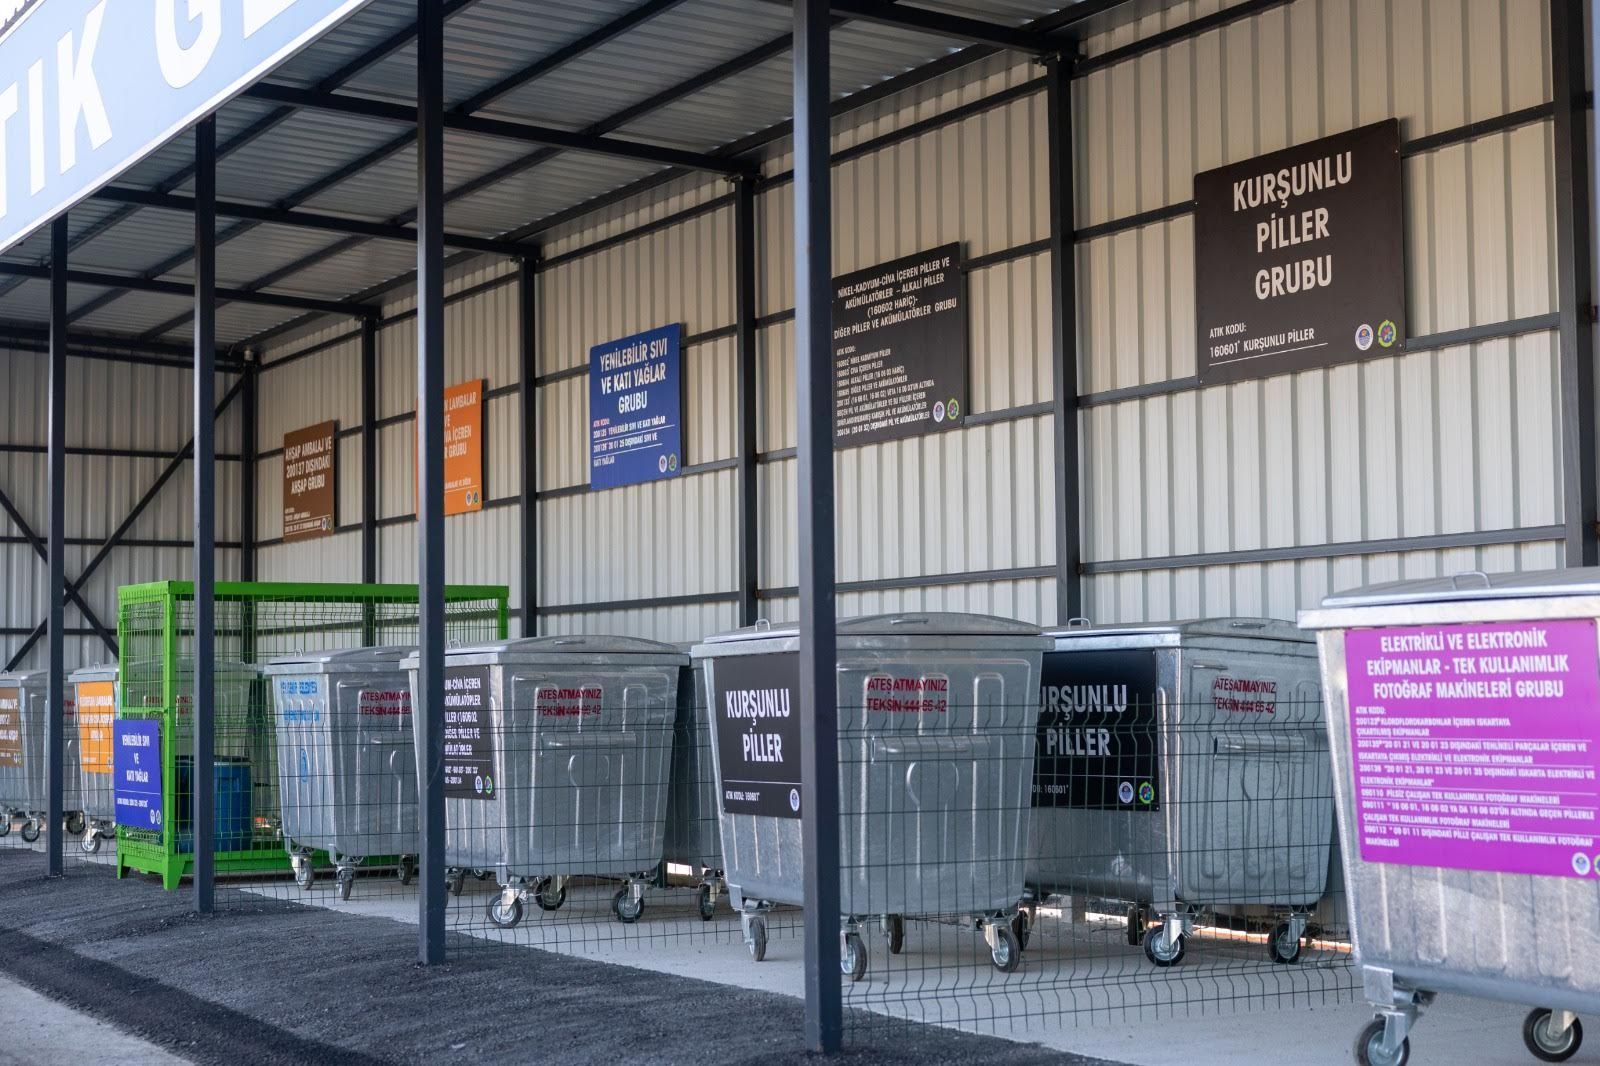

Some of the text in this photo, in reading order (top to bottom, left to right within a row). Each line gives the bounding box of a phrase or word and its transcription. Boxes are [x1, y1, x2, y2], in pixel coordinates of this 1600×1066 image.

[1234, 152, 1351, 212] KURŞUNLU
[1257, 207, 1330, 252] PİLLER
[897, 266, 918, 282] İÇEREN
[920, 260, 940, 275] PİLLER
[942, 257, 949, 268] VE
[1256, 255, 1331, 299] GRUBU
[845, 273, 944, 310] AKÜMÜLATÖRLER ALKALİ PİLLER
[834, 298, 956, 339] DİĞER PİLLER VE AKÜMÜLATÖRLER GRUBU
[1210, 323, 1246, 338] ATIK KODU:
[1244, 332, 1285, 352] KURŞUNLU
[1288, 328, 1314, 343] PİLLER
[600, 338, 667, 372] YENİLEBİLİR SIVI
[601, 362, 665, 395] VE KATI YAĞLAR
[619, 391, 647, 413] GRUBU
[326, 436, 331, 449] VE
[453, 424, 471, 441] İÇEREN
[449, 443, 466, 458] GRUBU
[291, 474, 324, 496] AHŞAP GRUBU
[1381, 627, 1547, 652] ELEKTRİKLİ VE ELEKTRONİK
[1367, 655, 1569, 676] EKİPMANLAR TEK KULLANIMLIK
[464, 676, 480, 691] İÇEREN
[893, 679, 947, 691] ATMAYINIZ
[1374, 678, 1563, 699] FOTOĞRAF MAKİNELERİ GRUBU
[726, 689, 790, 725] KURŞUNLU
[867, 696, 901, 712] TEKSİN
[1040, 685, 1127, 720] URŞUNLU
[743, 728, 783, 762] PİLLER
[1047, 723, 1110, 755] PİLLER
[1577, 742, 1586, 752] VE
[134, 753, 139, 764] VE
[1585, 770, 1595, 779] VE
